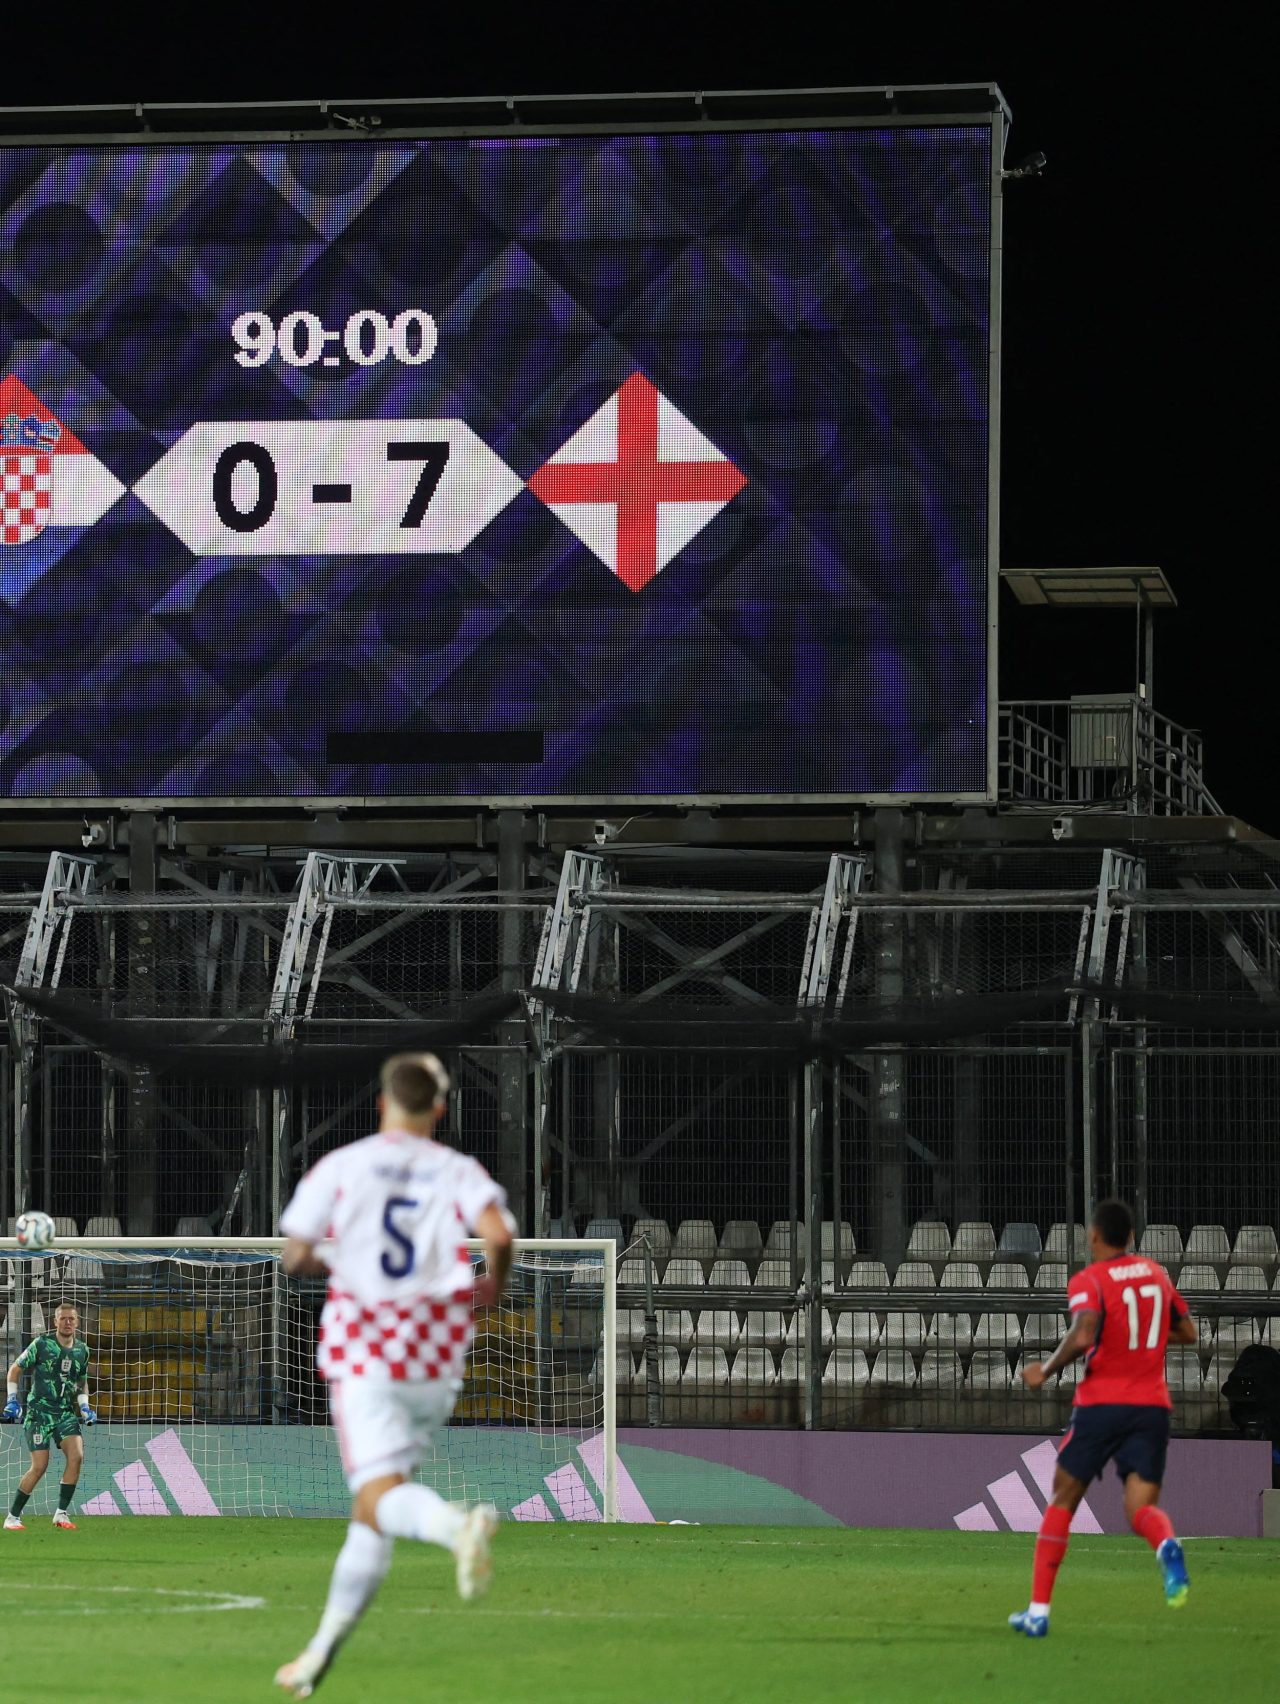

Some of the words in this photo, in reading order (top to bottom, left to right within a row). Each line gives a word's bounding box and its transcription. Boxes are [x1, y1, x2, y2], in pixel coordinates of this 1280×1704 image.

[231, 308, 439, 368] 90:00
[212, 441, 278, 533] 0
[386, 441, 451, 529] 7
[380, 1196, 419, 1279] 5
[1122, 1284, 1164, 1350] 17
